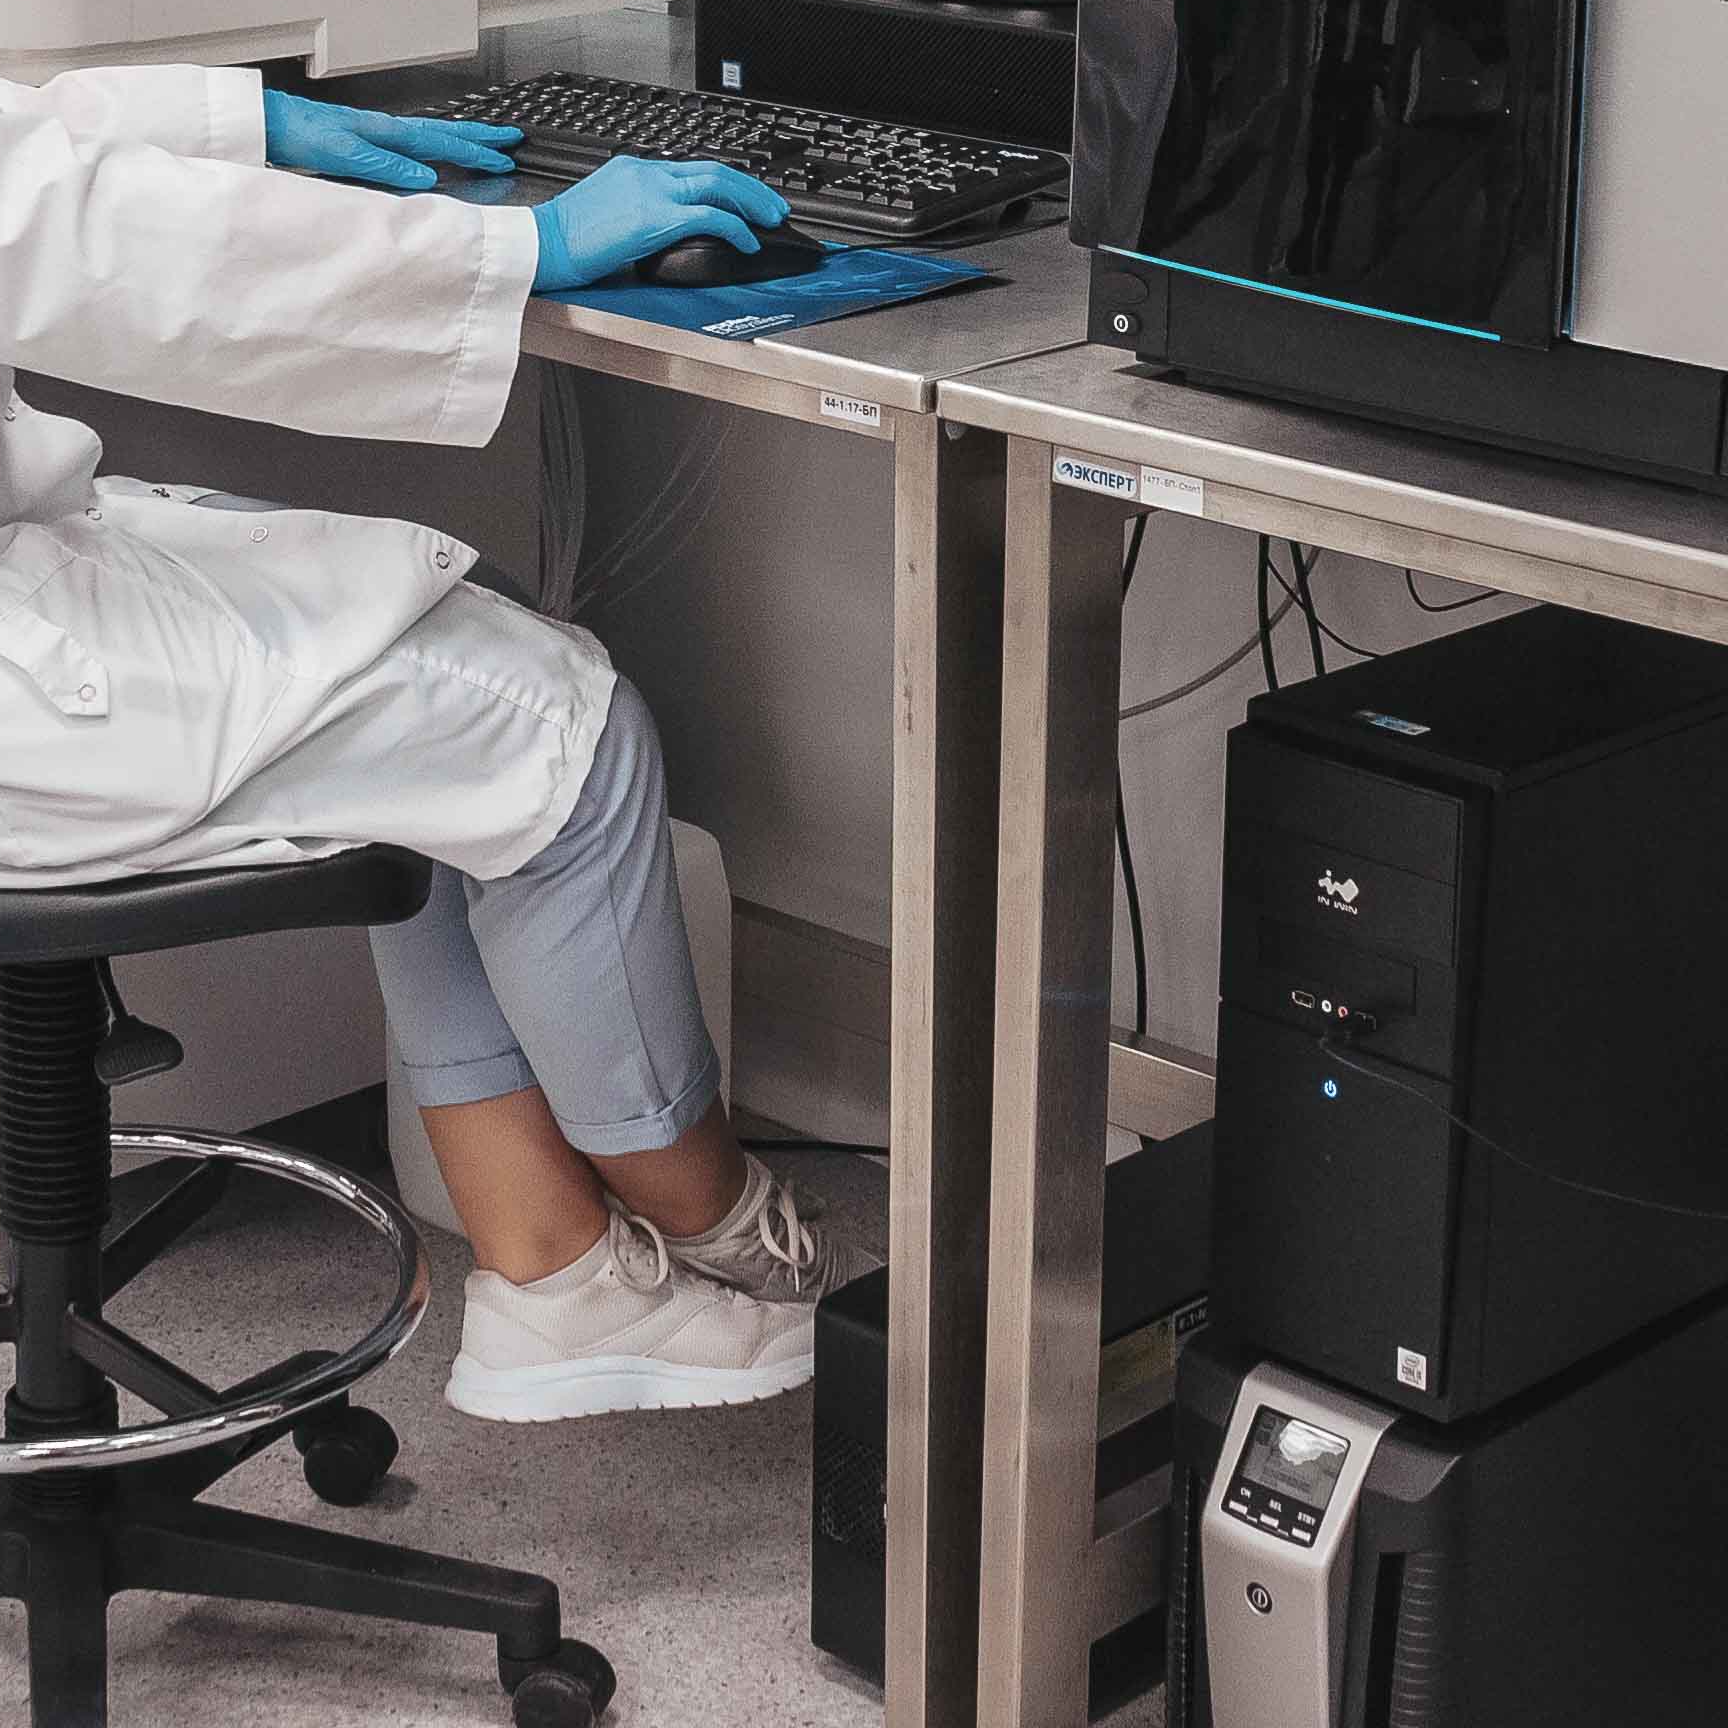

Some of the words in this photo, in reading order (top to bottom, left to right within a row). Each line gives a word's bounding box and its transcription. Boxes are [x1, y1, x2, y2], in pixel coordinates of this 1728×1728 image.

[824, 397, 877, 418] 44-1.17-БП
[1073, 465, 1136, 492] ЭКСПЕРТ
[1317, 895, 1330, 906] IN
[1334, 901, 1358, 915] WIN
